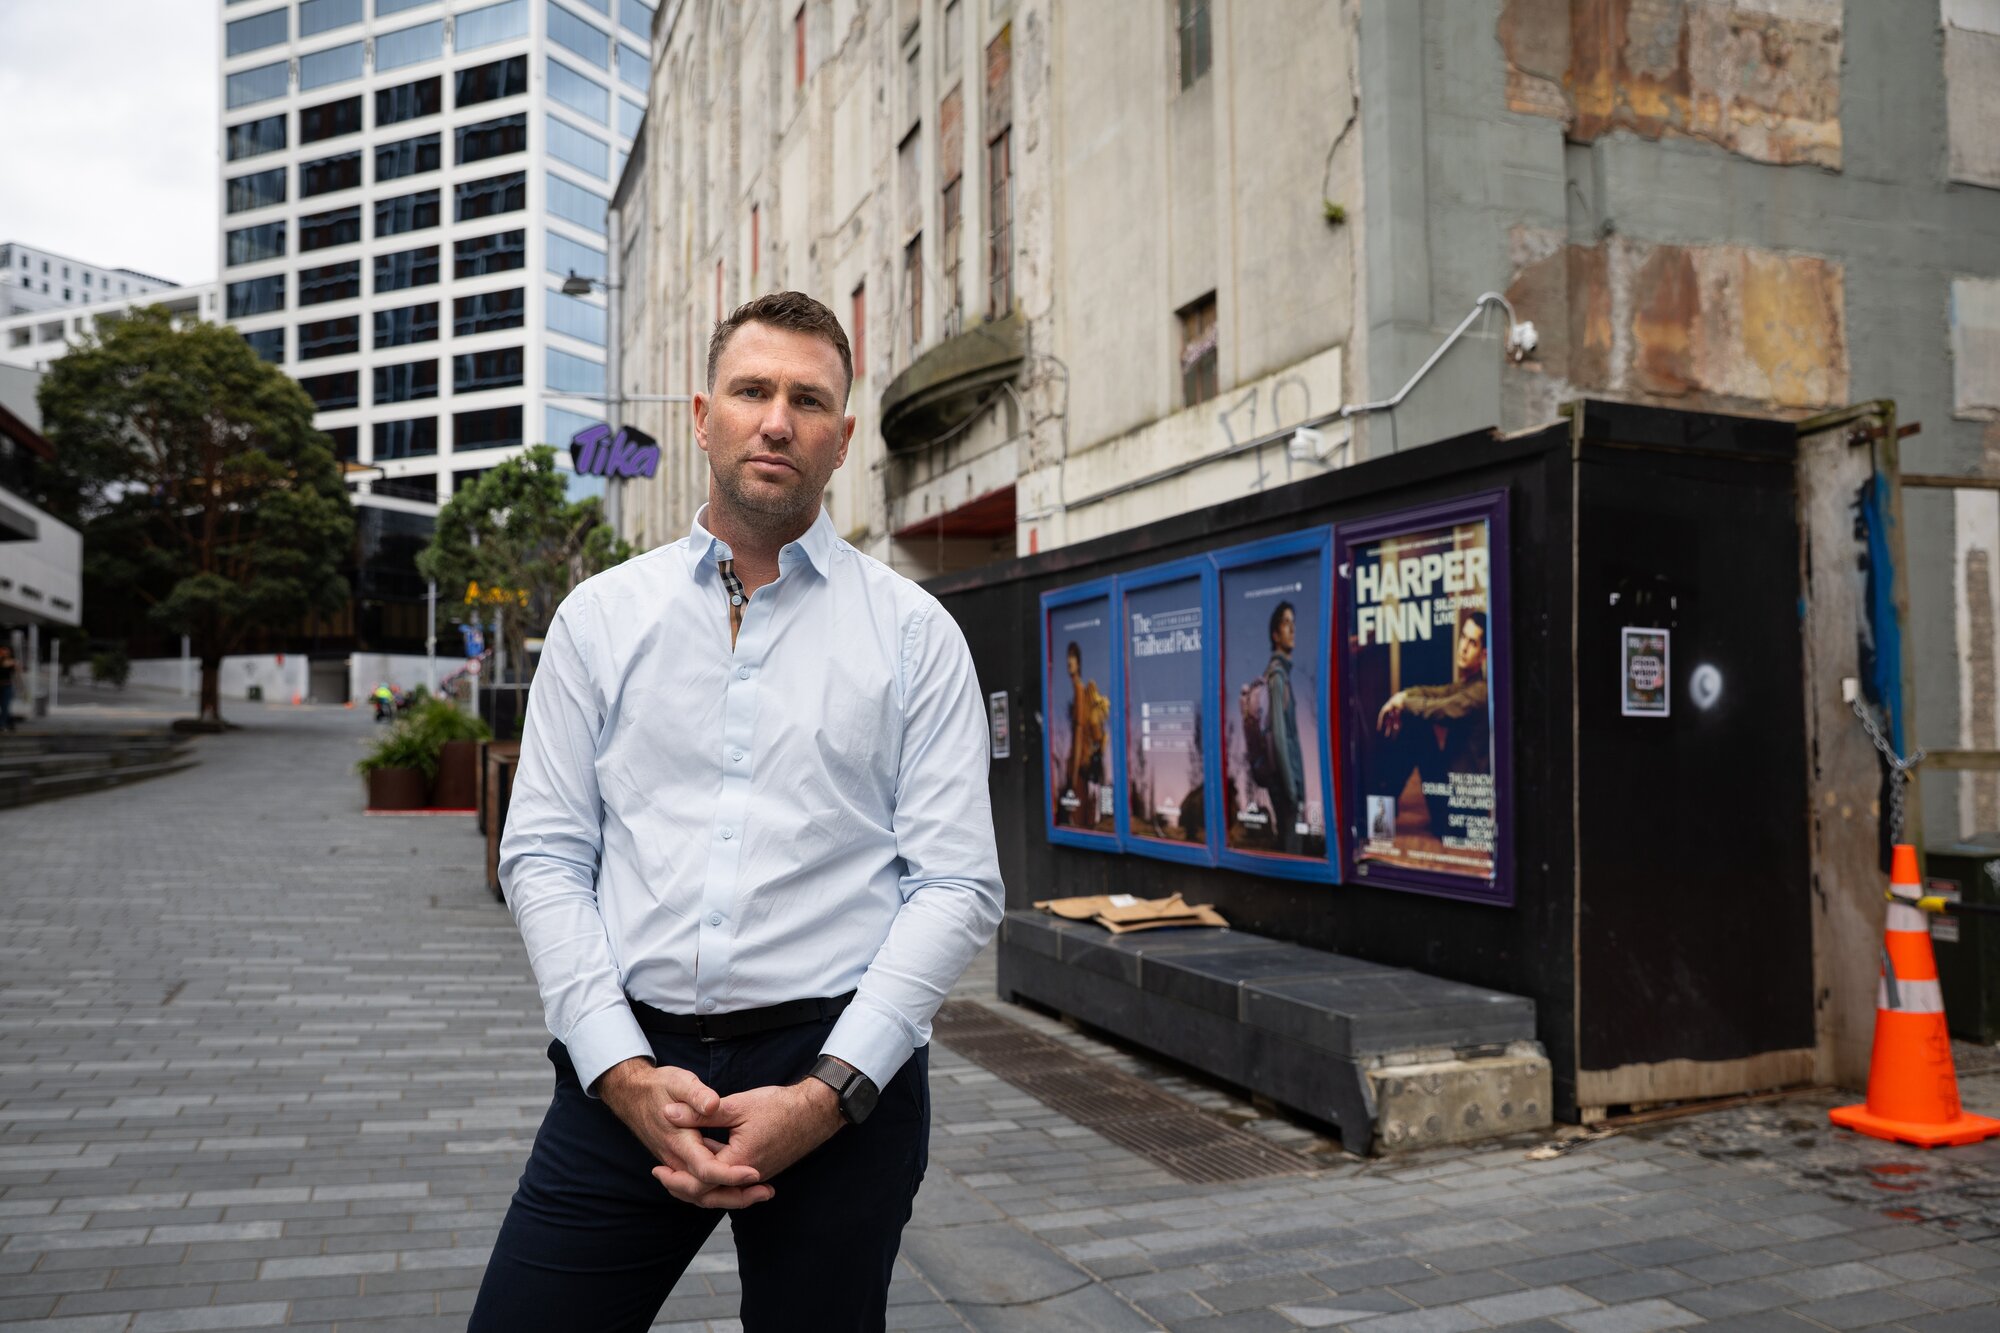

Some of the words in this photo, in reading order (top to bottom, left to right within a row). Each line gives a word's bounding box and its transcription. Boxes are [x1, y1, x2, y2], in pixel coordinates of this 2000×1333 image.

[573, 423, 660, 479] Tika
[1356, 547, 1487, 605] HARPER
[1131, 613, 1152, 634] The
[1357, 600, 1432, 646] FINN
[1176, 627, 1202, 653] Pack
[1422, 783, 1453, 796] DOUBLE
[1448, 796, 1494, 809] AUCKLAND
